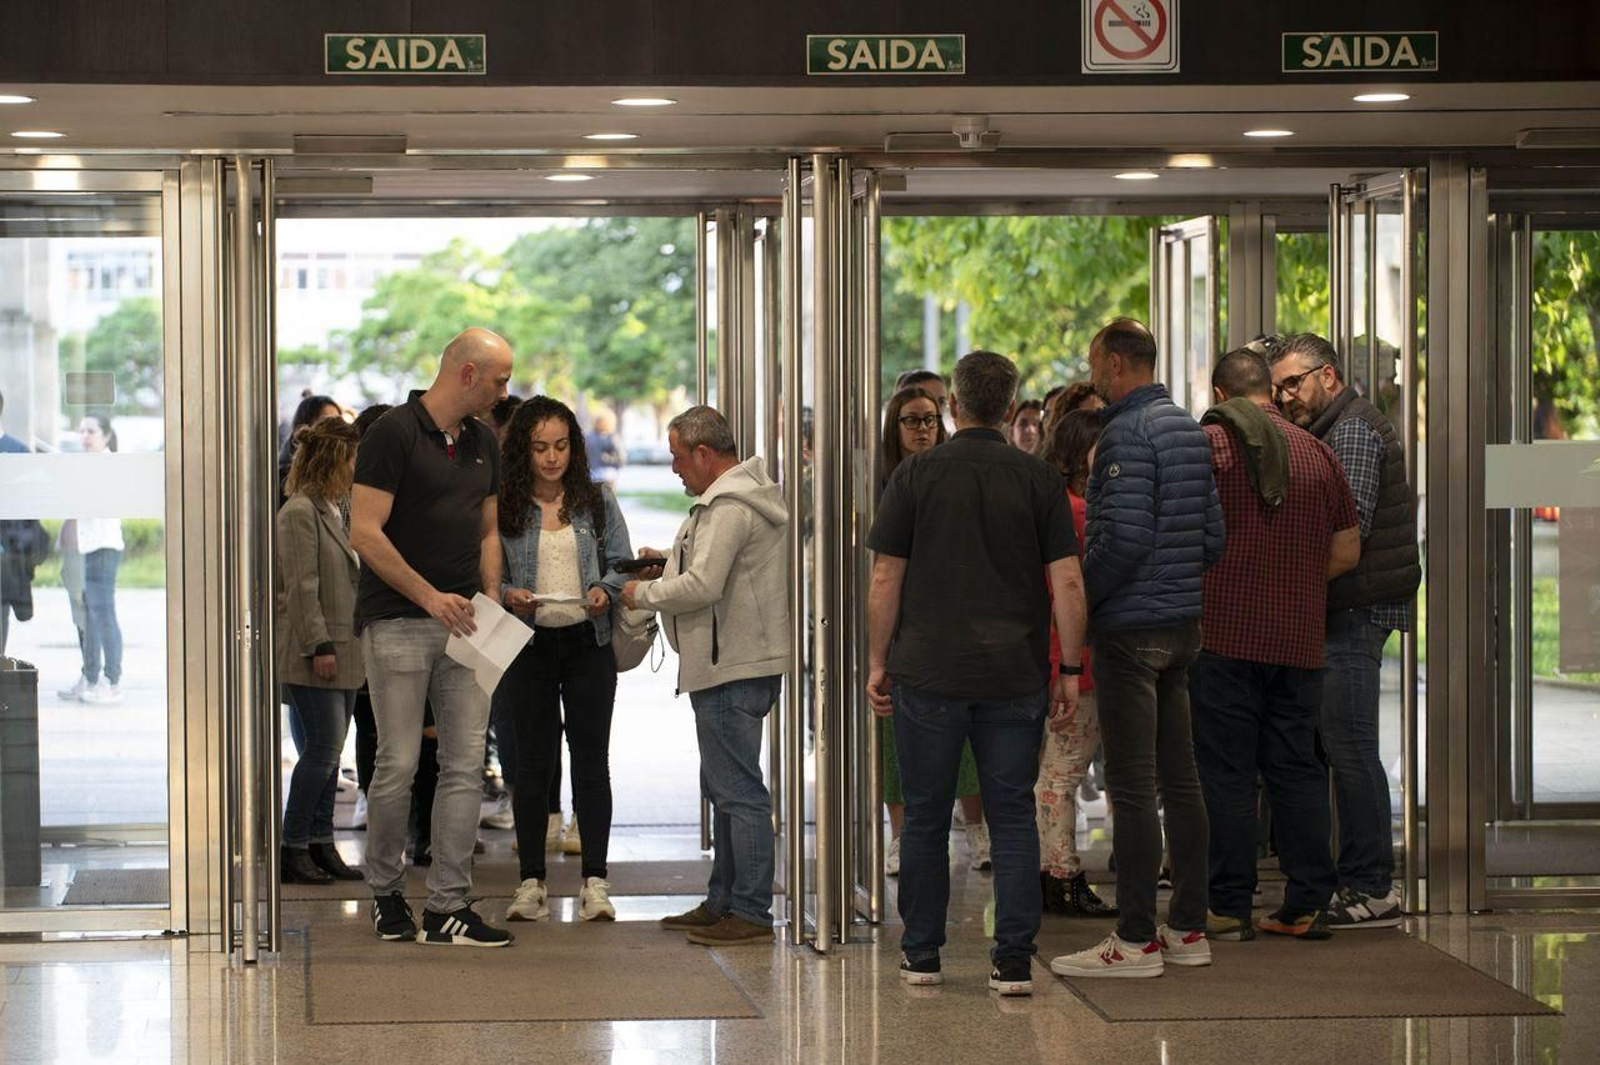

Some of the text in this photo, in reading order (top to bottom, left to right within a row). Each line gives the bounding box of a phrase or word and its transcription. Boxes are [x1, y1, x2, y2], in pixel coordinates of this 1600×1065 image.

[345, 38, 466, 70] SAIDA
[827, 38, 945, 70] SAIDA
[1302, 36, 1419, 68] SAIDA
